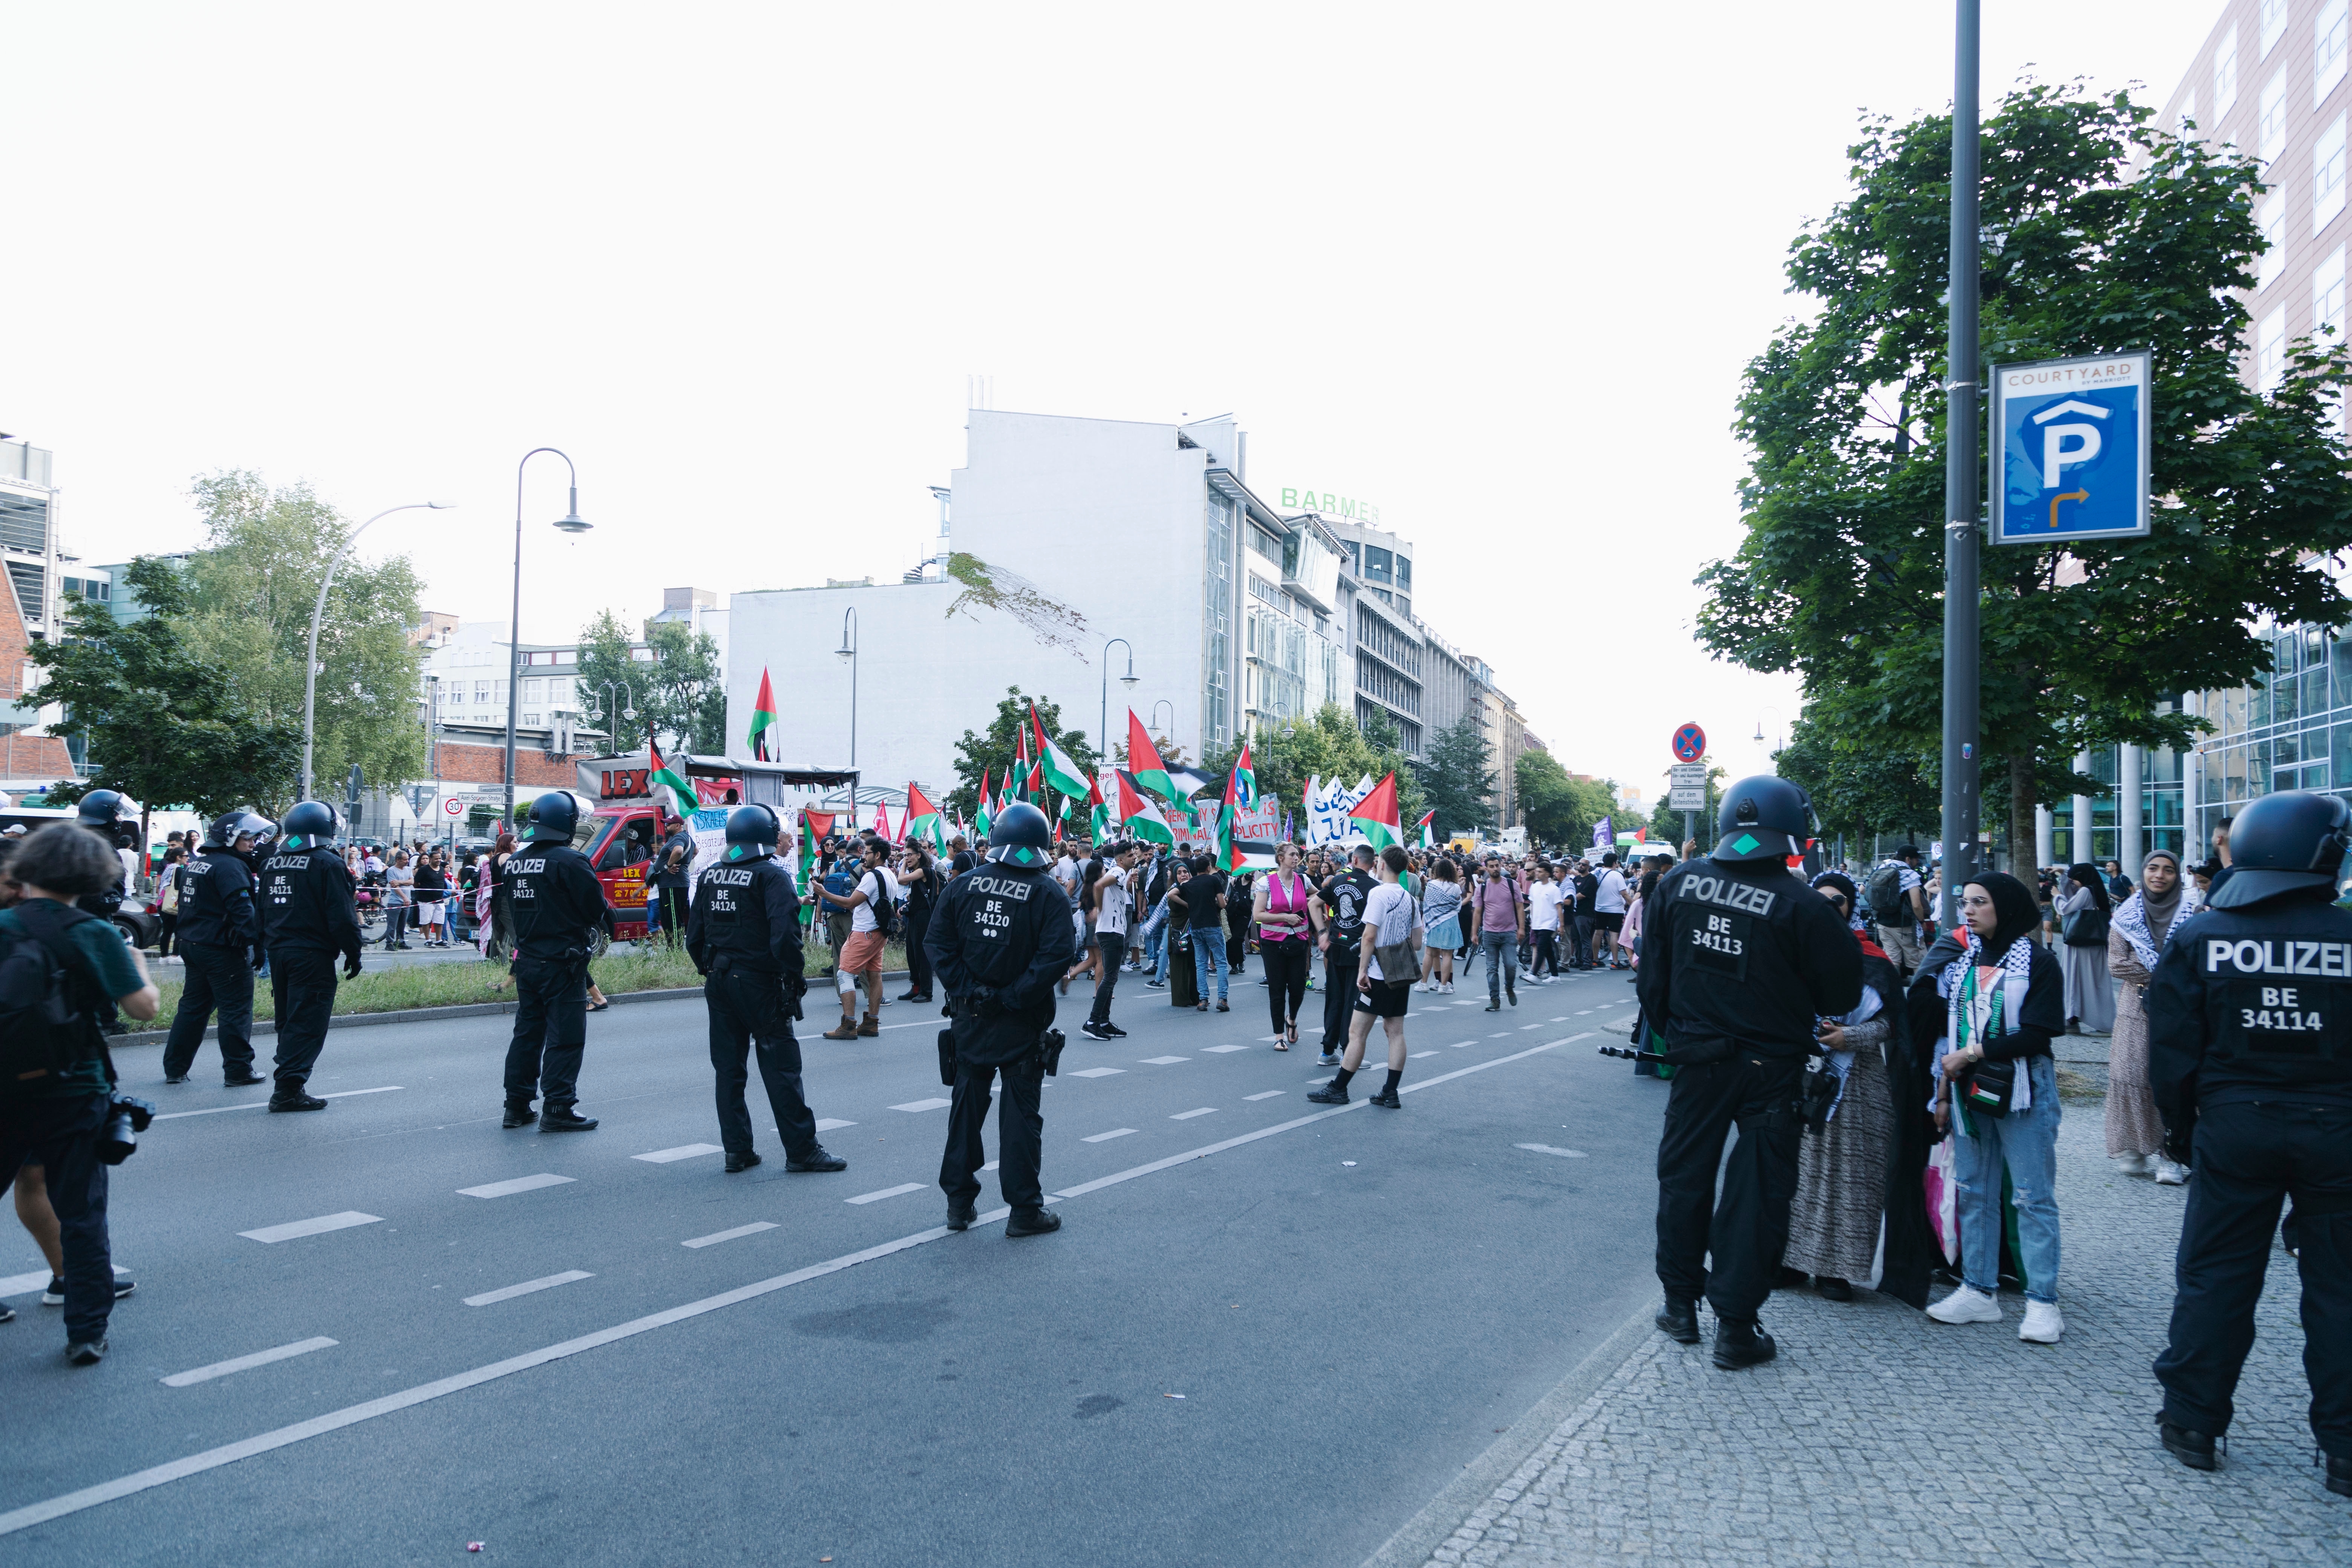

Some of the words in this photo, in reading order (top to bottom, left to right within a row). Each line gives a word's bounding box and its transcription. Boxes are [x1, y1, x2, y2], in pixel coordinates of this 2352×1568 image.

[2009, 364, 2131, 386] COURTYARD
[2044, 423, 2102, 488] P
[1282, 488, 1380, 526] BARMER
[601, 769, 653, 800] LEX
[1165, 808, 1207, 822] GERMNY
[1264, 801, 1275, 816] IS
[694, 811, 727, 830] ISRAELS
[1173, 828, 1211, 841] RIMINAL
[1238, 823, 1278, 839] PLICITY
[695, 834, 726, 849] Besatzun
[185, 861, 212, 874] POLIZEI
[265, 855, 310, 870] POLIZEI
[504, 859, 546, 874] POLIZEI
[275, 876, 286, 885] BE
[623, 869, 641, 877] LEX
[704, 869, 753, 886] POLIZEI
[186, 877, 192, 886] BE
[517, 879, 527, 888] BE
[968, 876, 1031, 900] POLIZEI
[269, 886, 292, 895] 34121
[513, 889, 534, 898] 34122
[717, 890, 729, 899] BE
[1336, 886, 1360, 898] PALESTINE
[1679, 874, 1776, 916] POLIZEI
[711, 901, 736, 911] 34124
[986, 900, 1002, 913] BE
[974, 912, 1009, 927] 34120
[1707, 914, 1731, 934] BE
[1692, 929, 1743, 955] 34113
[2207, 940, 2352, 977] POLIZEI
[2262, 987, 2298, 1007] BE
[1989, 990, 2004, 1034] Palestine
[2241, 1009, 2323, 1031] 34114
